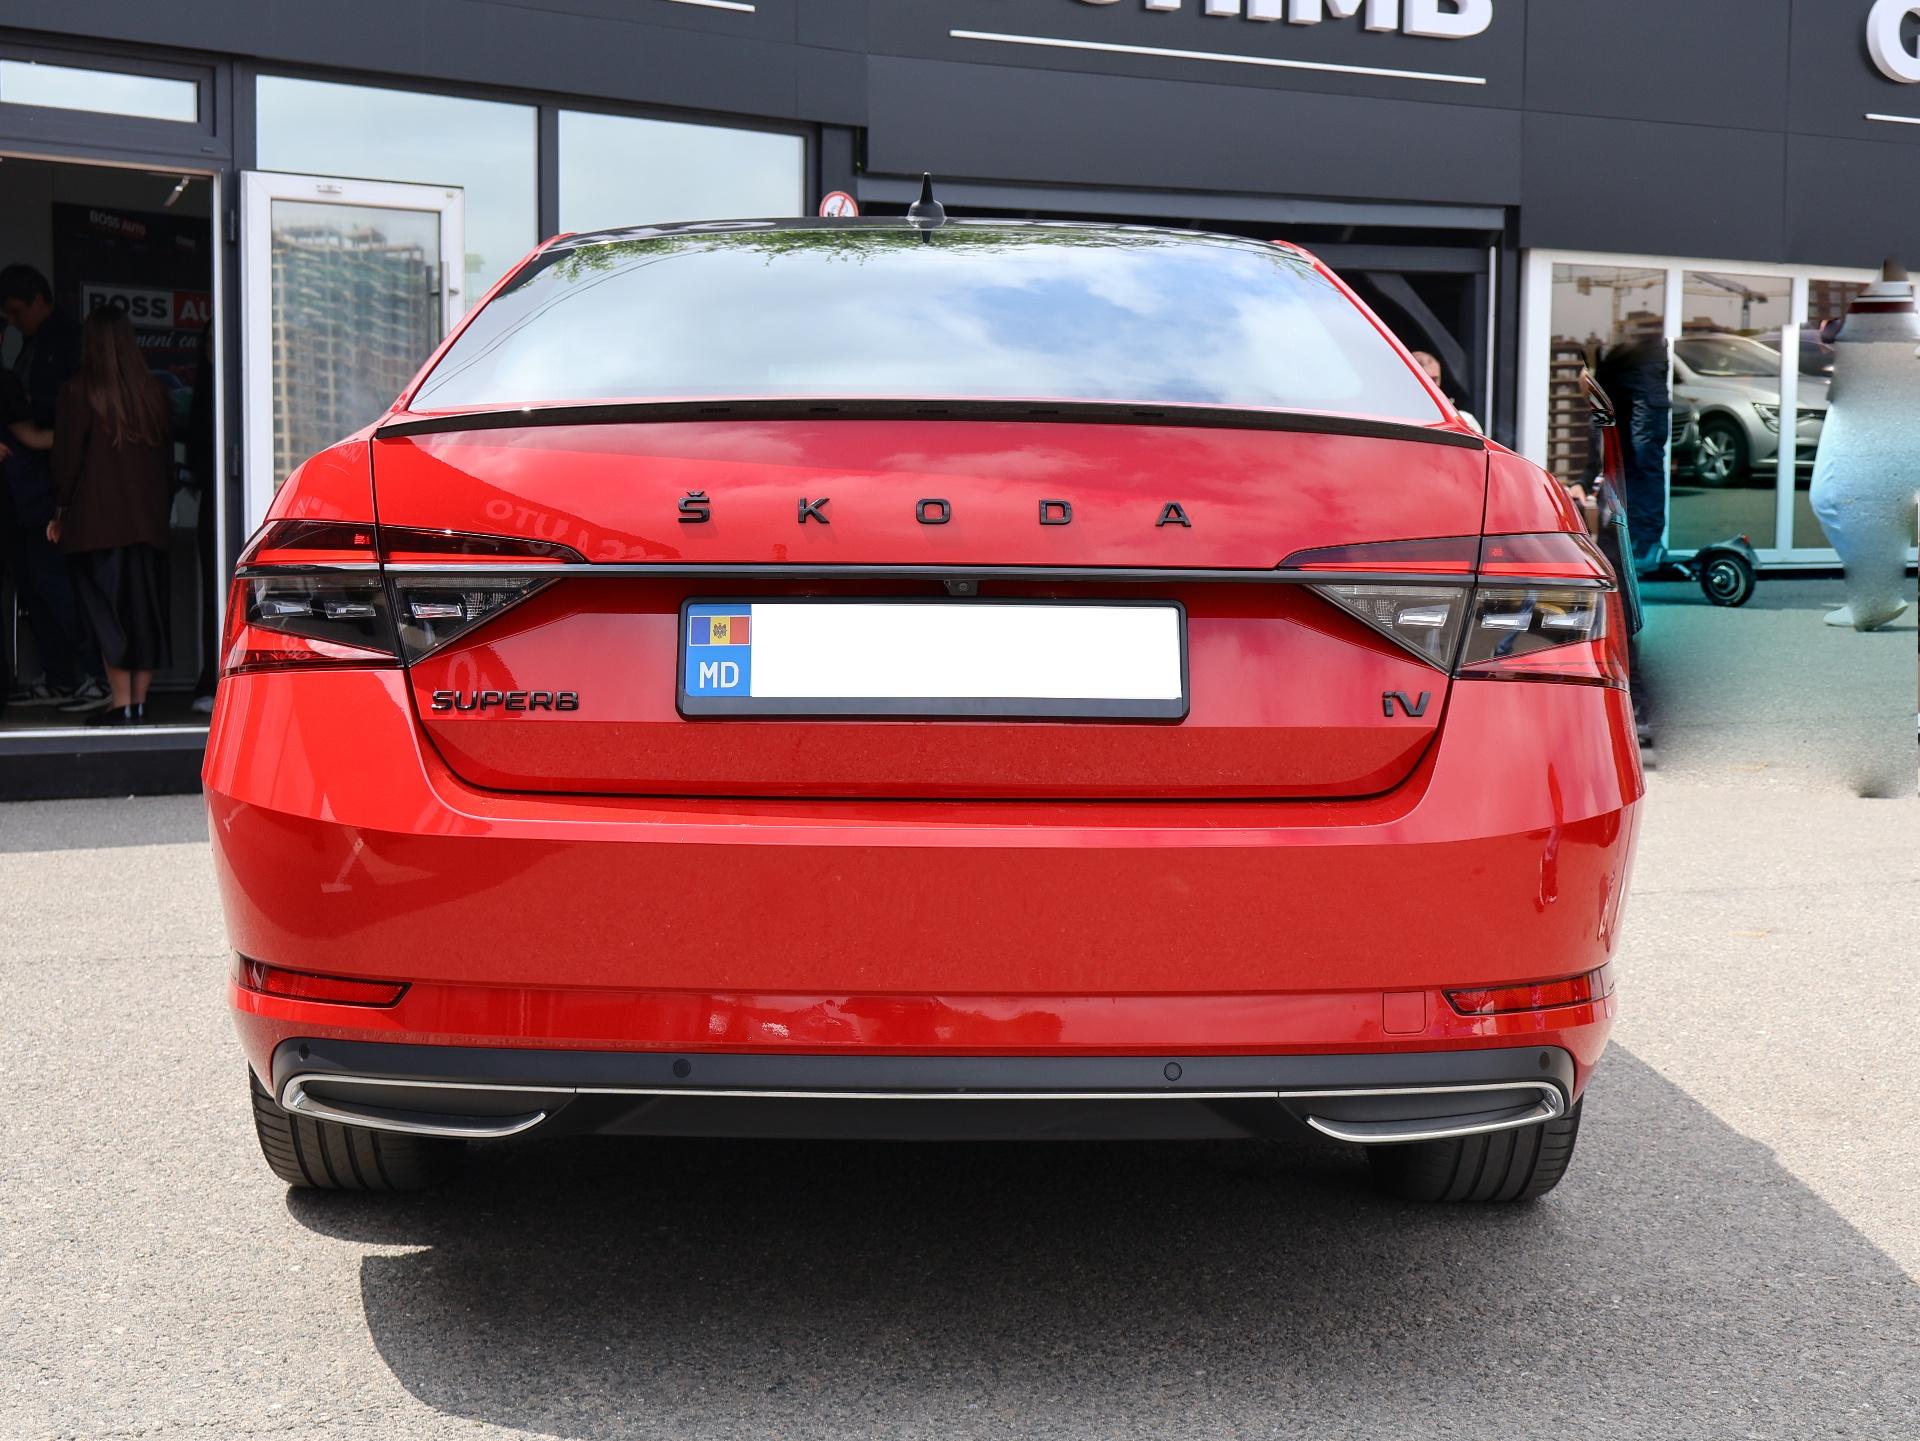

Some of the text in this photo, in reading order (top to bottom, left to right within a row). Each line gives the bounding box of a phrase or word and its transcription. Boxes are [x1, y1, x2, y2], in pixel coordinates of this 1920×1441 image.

[677, 490, 1192, 527] ŠKODA
[699, 661, 739, 689] MD
[431, 690, 580, 711] SUPERB
